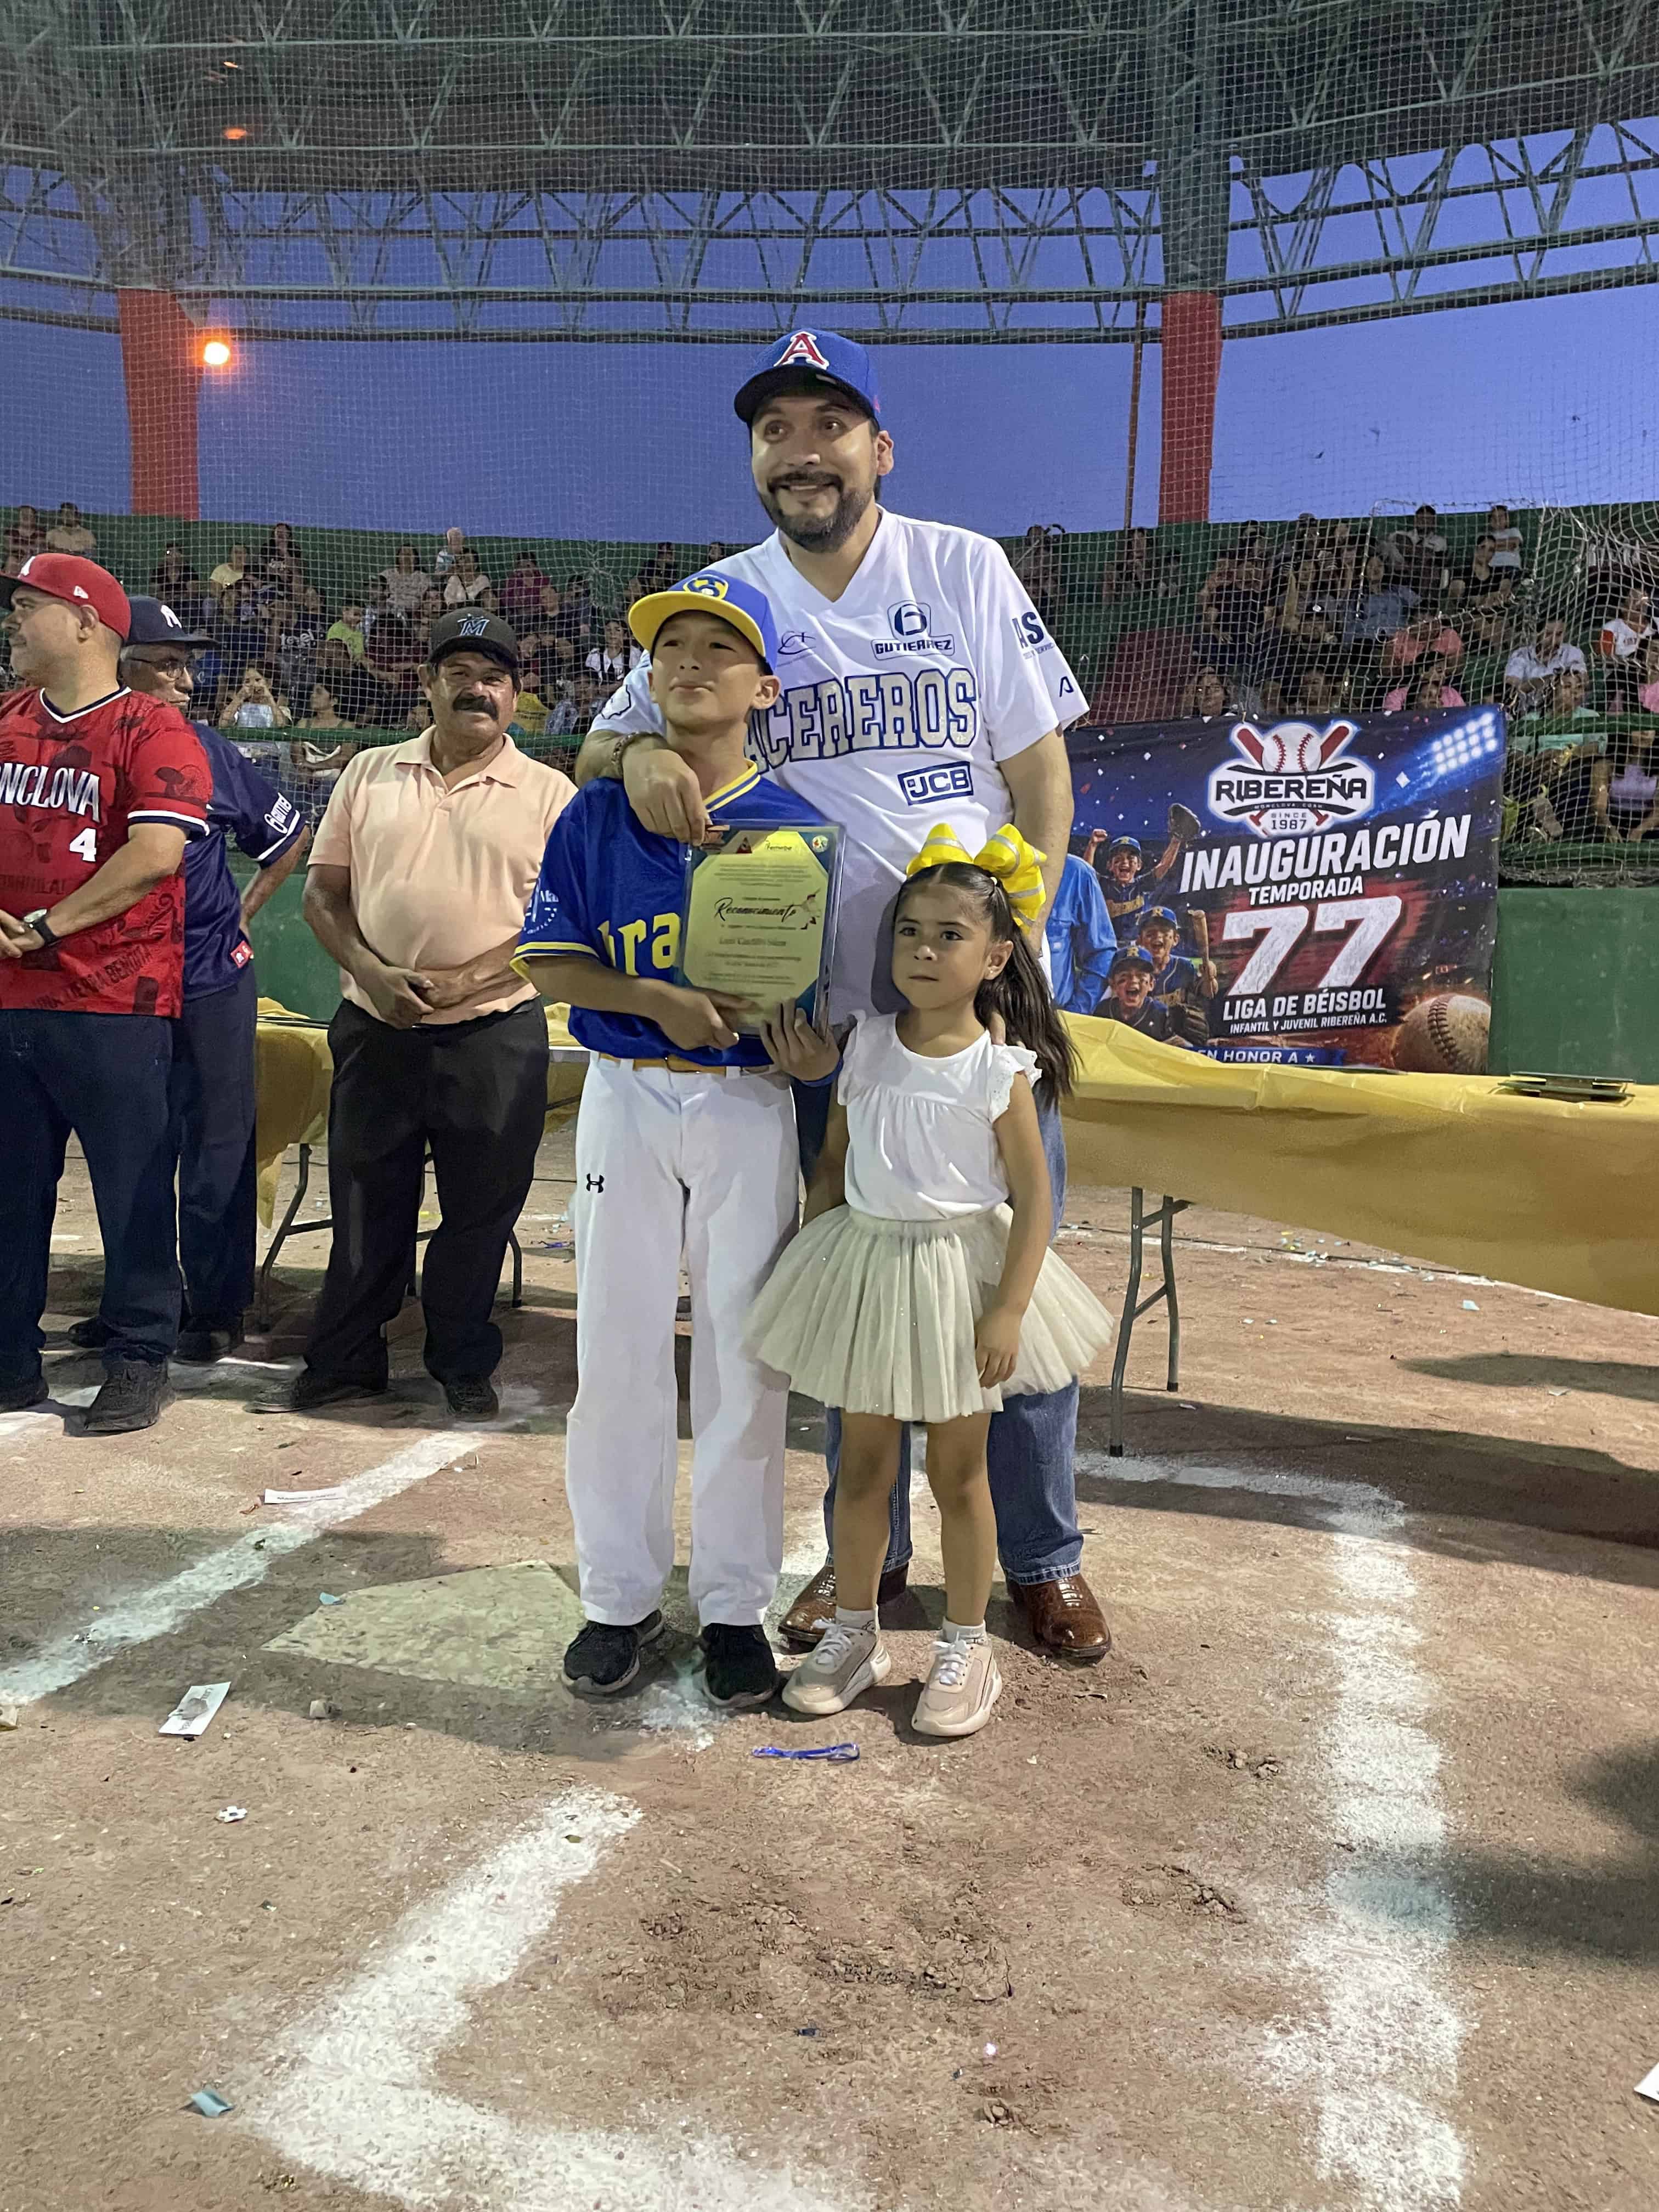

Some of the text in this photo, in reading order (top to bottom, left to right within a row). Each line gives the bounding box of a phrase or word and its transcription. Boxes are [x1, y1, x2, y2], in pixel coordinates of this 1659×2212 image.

[773, 331, 830, 370] A
[874, 640, 953, 655] GUTIERREZ
[0, 763, 100, 823] NCLOVA
[907, 769, 970, 798] JCB
[1215, 774, 1367, 804] RIBEREÑA
[1271, 819, 1307, 831] 1987
[69, 827, 97, 862] 4
[1180, 810, 1471, 894] INAUGURACIÓN
[1249, 876, 1364, 905] TEMPORADA
[1222, 895, 1402, 996] 77
[1223, 988, 1387, 1021] LIGA DE BÉISBOL
[1230, 1013, 1388, 1034] INFANTIL Y JUVENIL RIBEREÑA A.C.
[1223, 1050, 1282, 1064] HONOR
[1287, 1052, 1299, 1063] A
